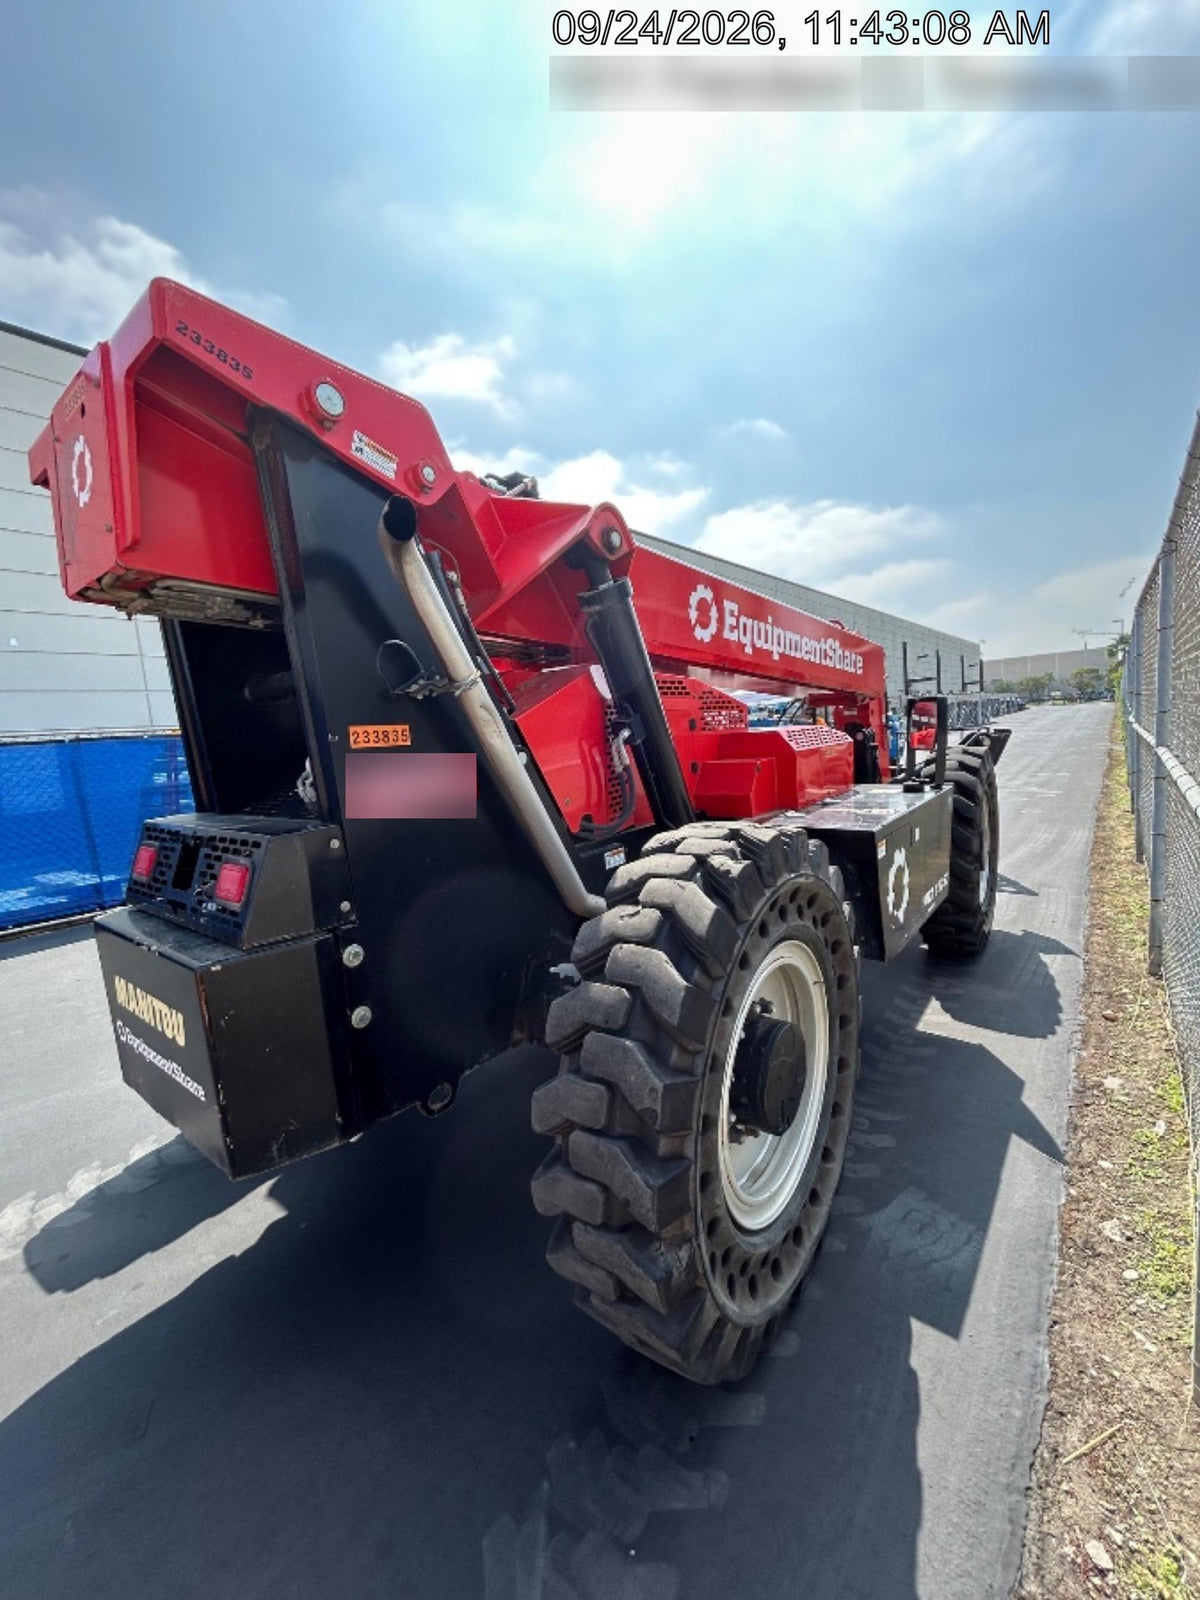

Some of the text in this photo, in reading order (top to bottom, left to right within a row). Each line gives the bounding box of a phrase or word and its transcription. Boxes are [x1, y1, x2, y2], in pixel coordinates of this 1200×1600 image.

[175, 319, 253, 380] 233835
[722, 598, 864, 675] EquipmentShare
[351, 728, 408, 745] 233835
